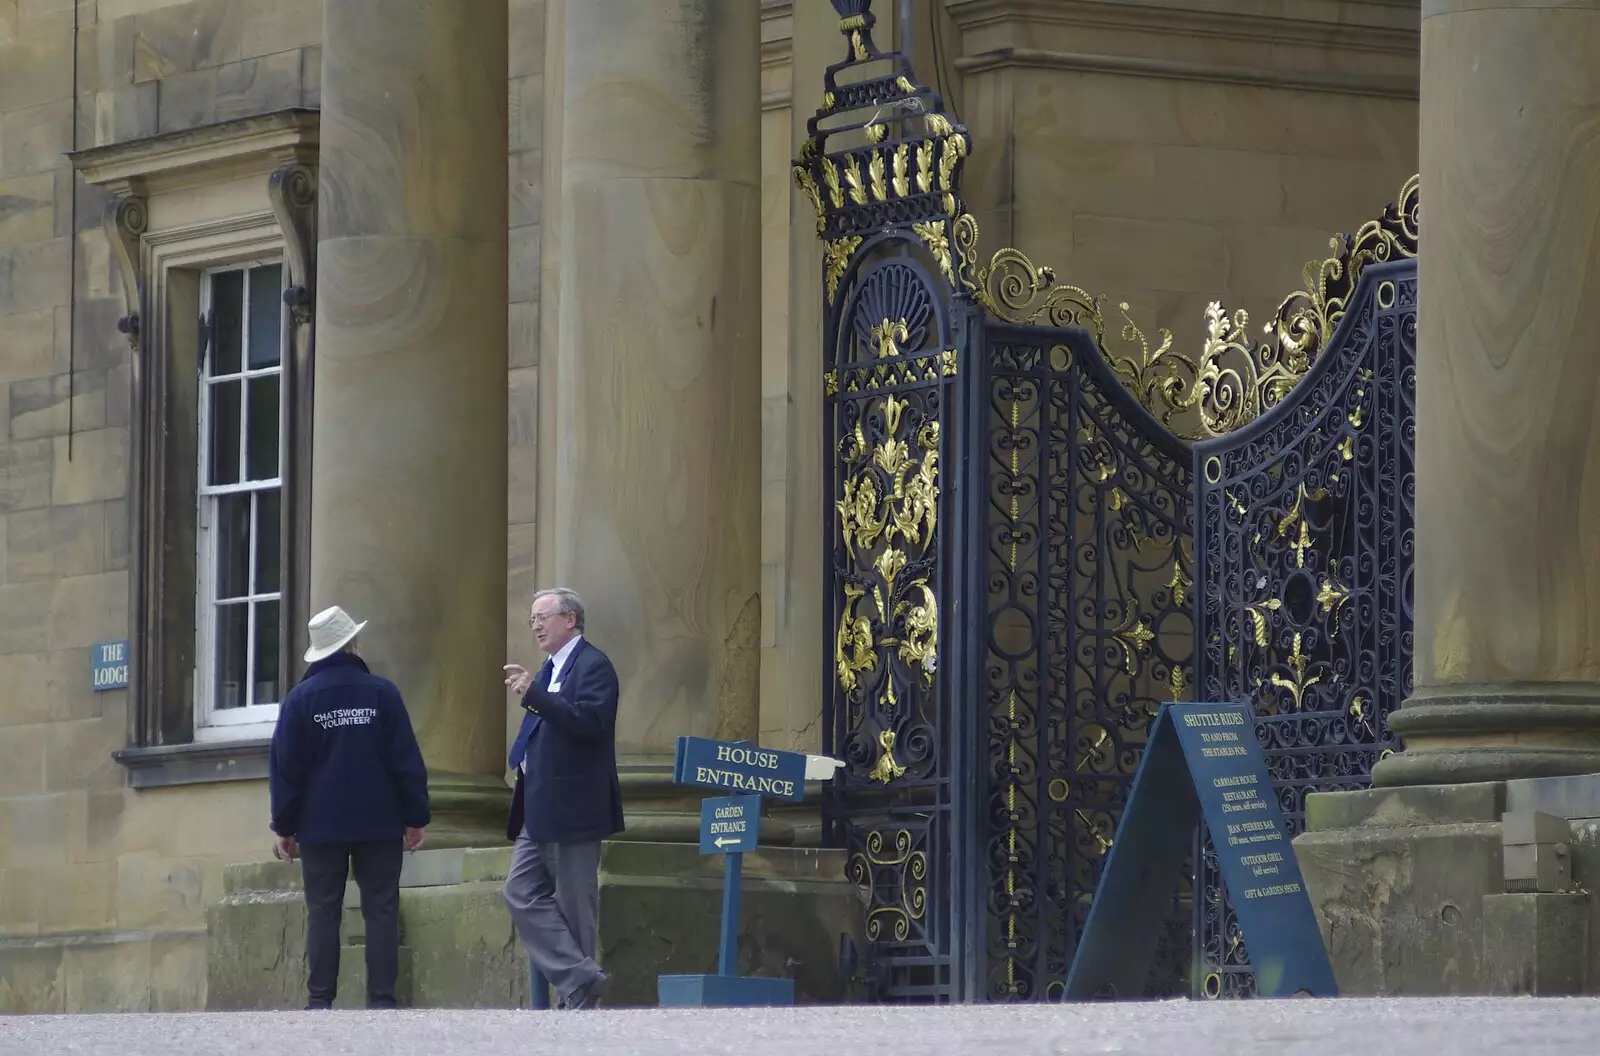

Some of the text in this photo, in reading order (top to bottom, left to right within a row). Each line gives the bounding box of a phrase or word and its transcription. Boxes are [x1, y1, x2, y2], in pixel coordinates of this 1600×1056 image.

[101, 644, 123, 662] THE
[313, 709, 376, 723] CHATSWORTH
[1184, 712, 1244, 727] SHUTTLE RIDES
[321, 717, 370, 729] VOLUNTEER
[1201, 732, 1239, 742] TO AND FROM
[717, 746, 778, 769] HOUSE
[1202, 748, 1214, 757] THE
[696, 767, 794, 796] ENTRANCE
[1213, 774, 1258, 787] CARRIAGE HOUSE
[1223, 789, 1258, 801] RESTAURANT
[715, 806, 744, 819] GARDEN
[710, 821, 746, 834] ENTRANCE
[1263, 820, 1275, 830] BAR
[1241, 852, 1284, 865] OUTDOOR GRILL
[1245, 883, 1301, 899] GIFT & GARDEN SHOPS
